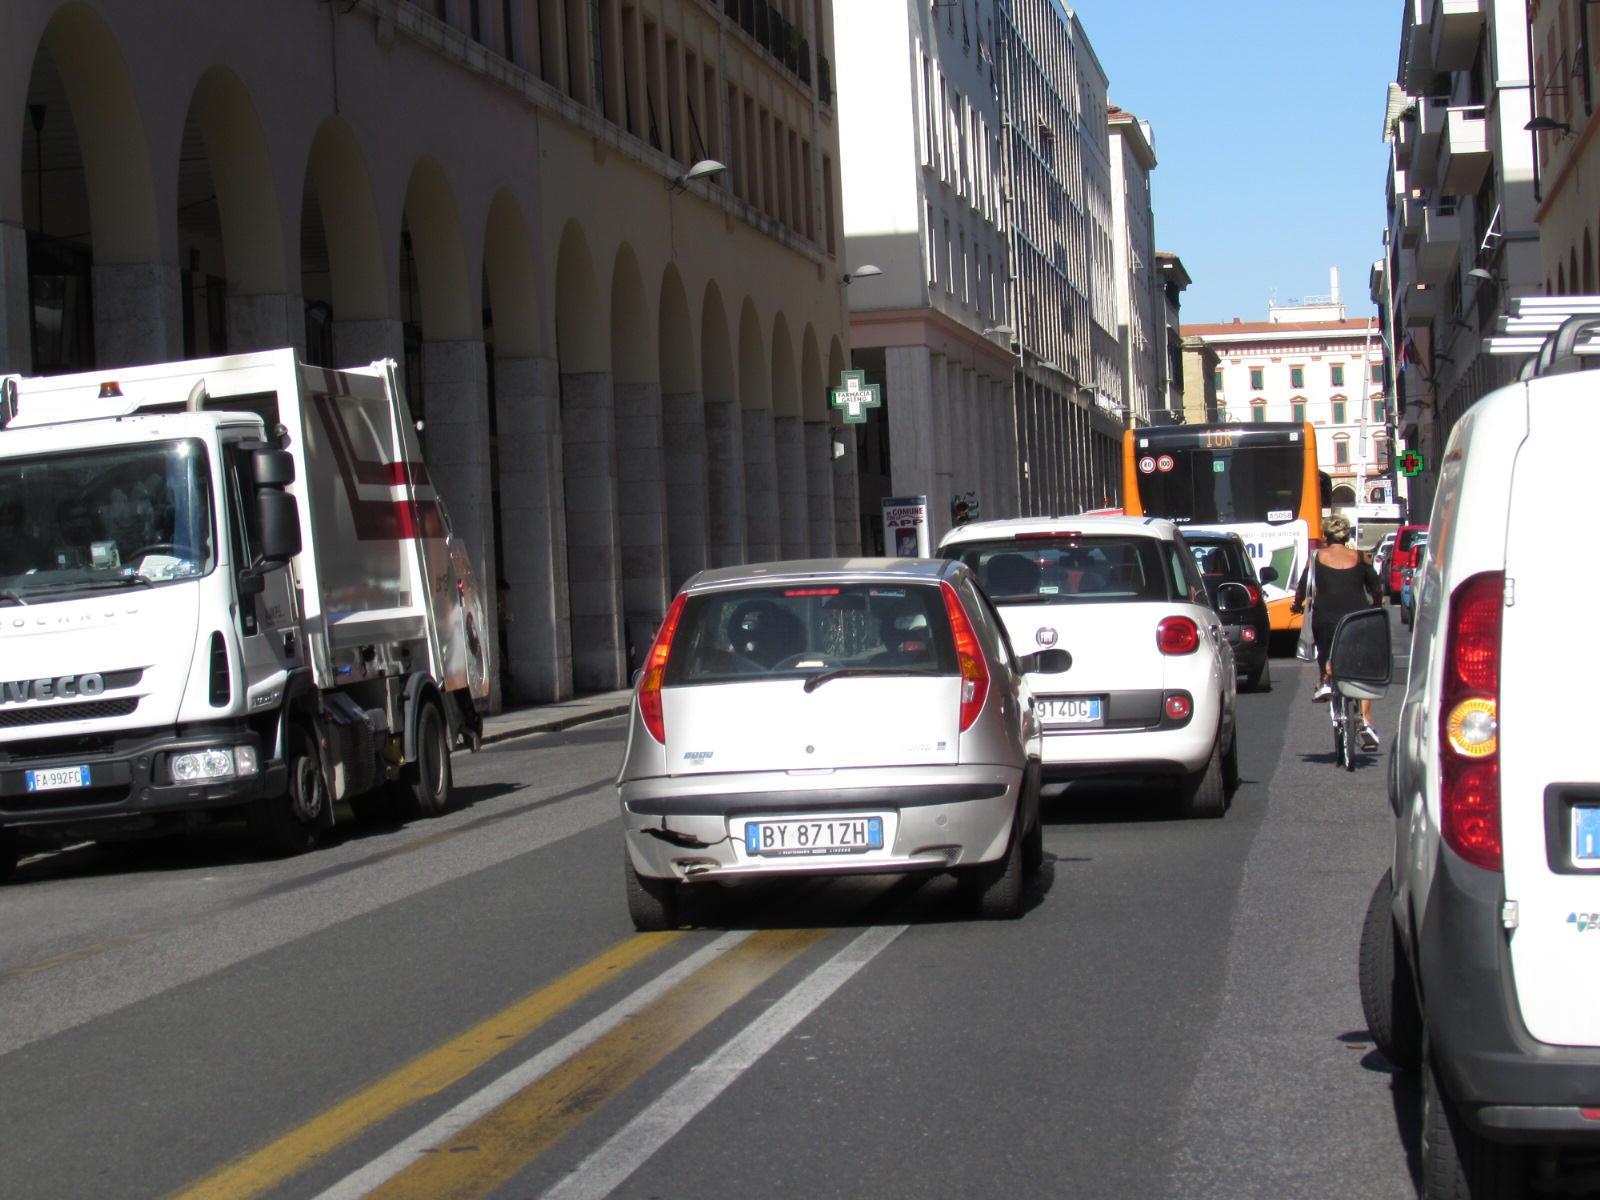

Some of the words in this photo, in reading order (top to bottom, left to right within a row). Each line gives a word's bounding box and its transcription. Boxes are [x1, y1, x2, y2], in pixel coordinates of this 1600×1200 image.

[892, 507, 923, 516] COMUNE
[888, 519, 923, 527] APP
[0, 672, 104, 704] IVECO
[762, 825, 787, 848] BY
[797, 822, 865, 846] 871ZH
